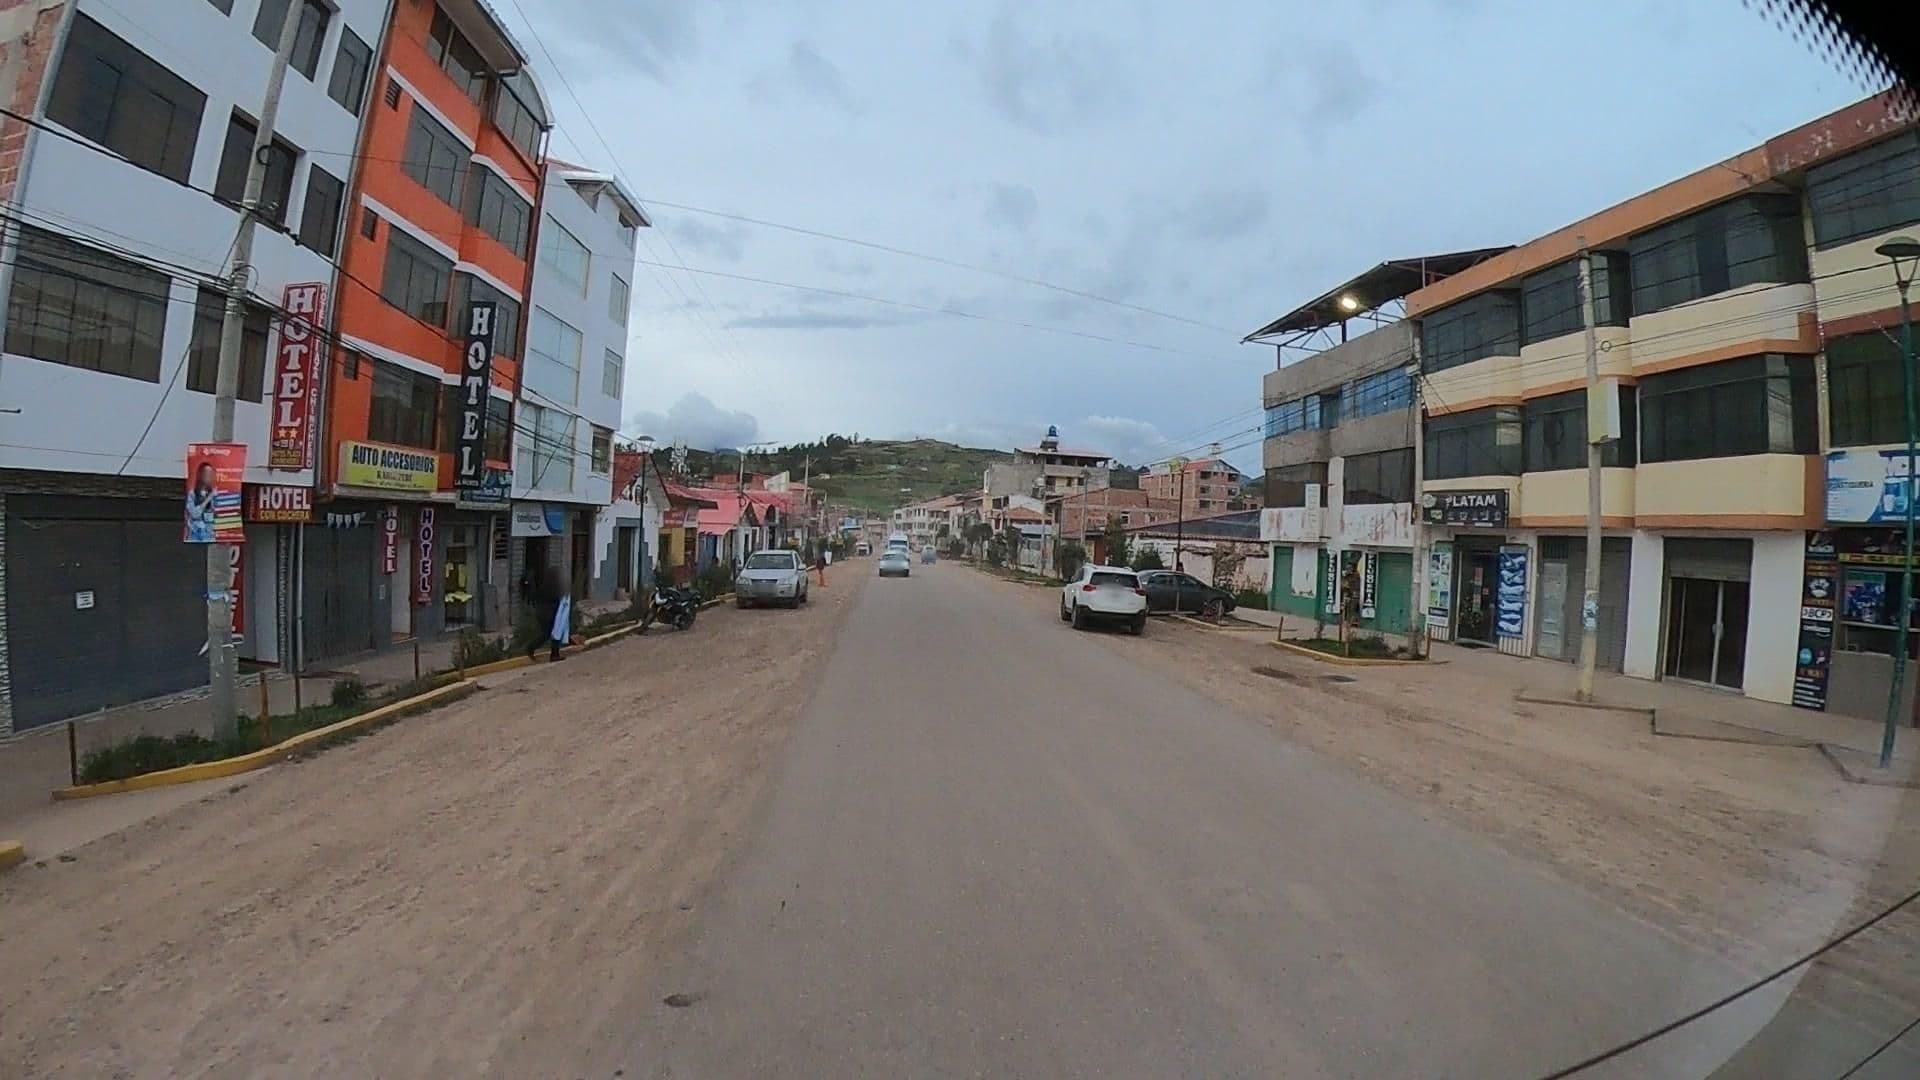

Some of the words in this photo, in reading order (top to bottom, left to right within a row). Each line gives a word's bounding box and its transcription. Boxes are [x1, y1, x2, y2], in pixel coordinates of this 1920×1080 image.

[278, 287, 317, 428] HOTEL
[460, 307, 491, 476] HOTEL
[352, 445, 379, 467] AUTO
[380, 449, 435, 474] ACCESORIOS
[259, 487, 311, 510] HOTEL
[385, 504, 399, 572] HOTEL
[419, 507, 435, 593] HOTEL
